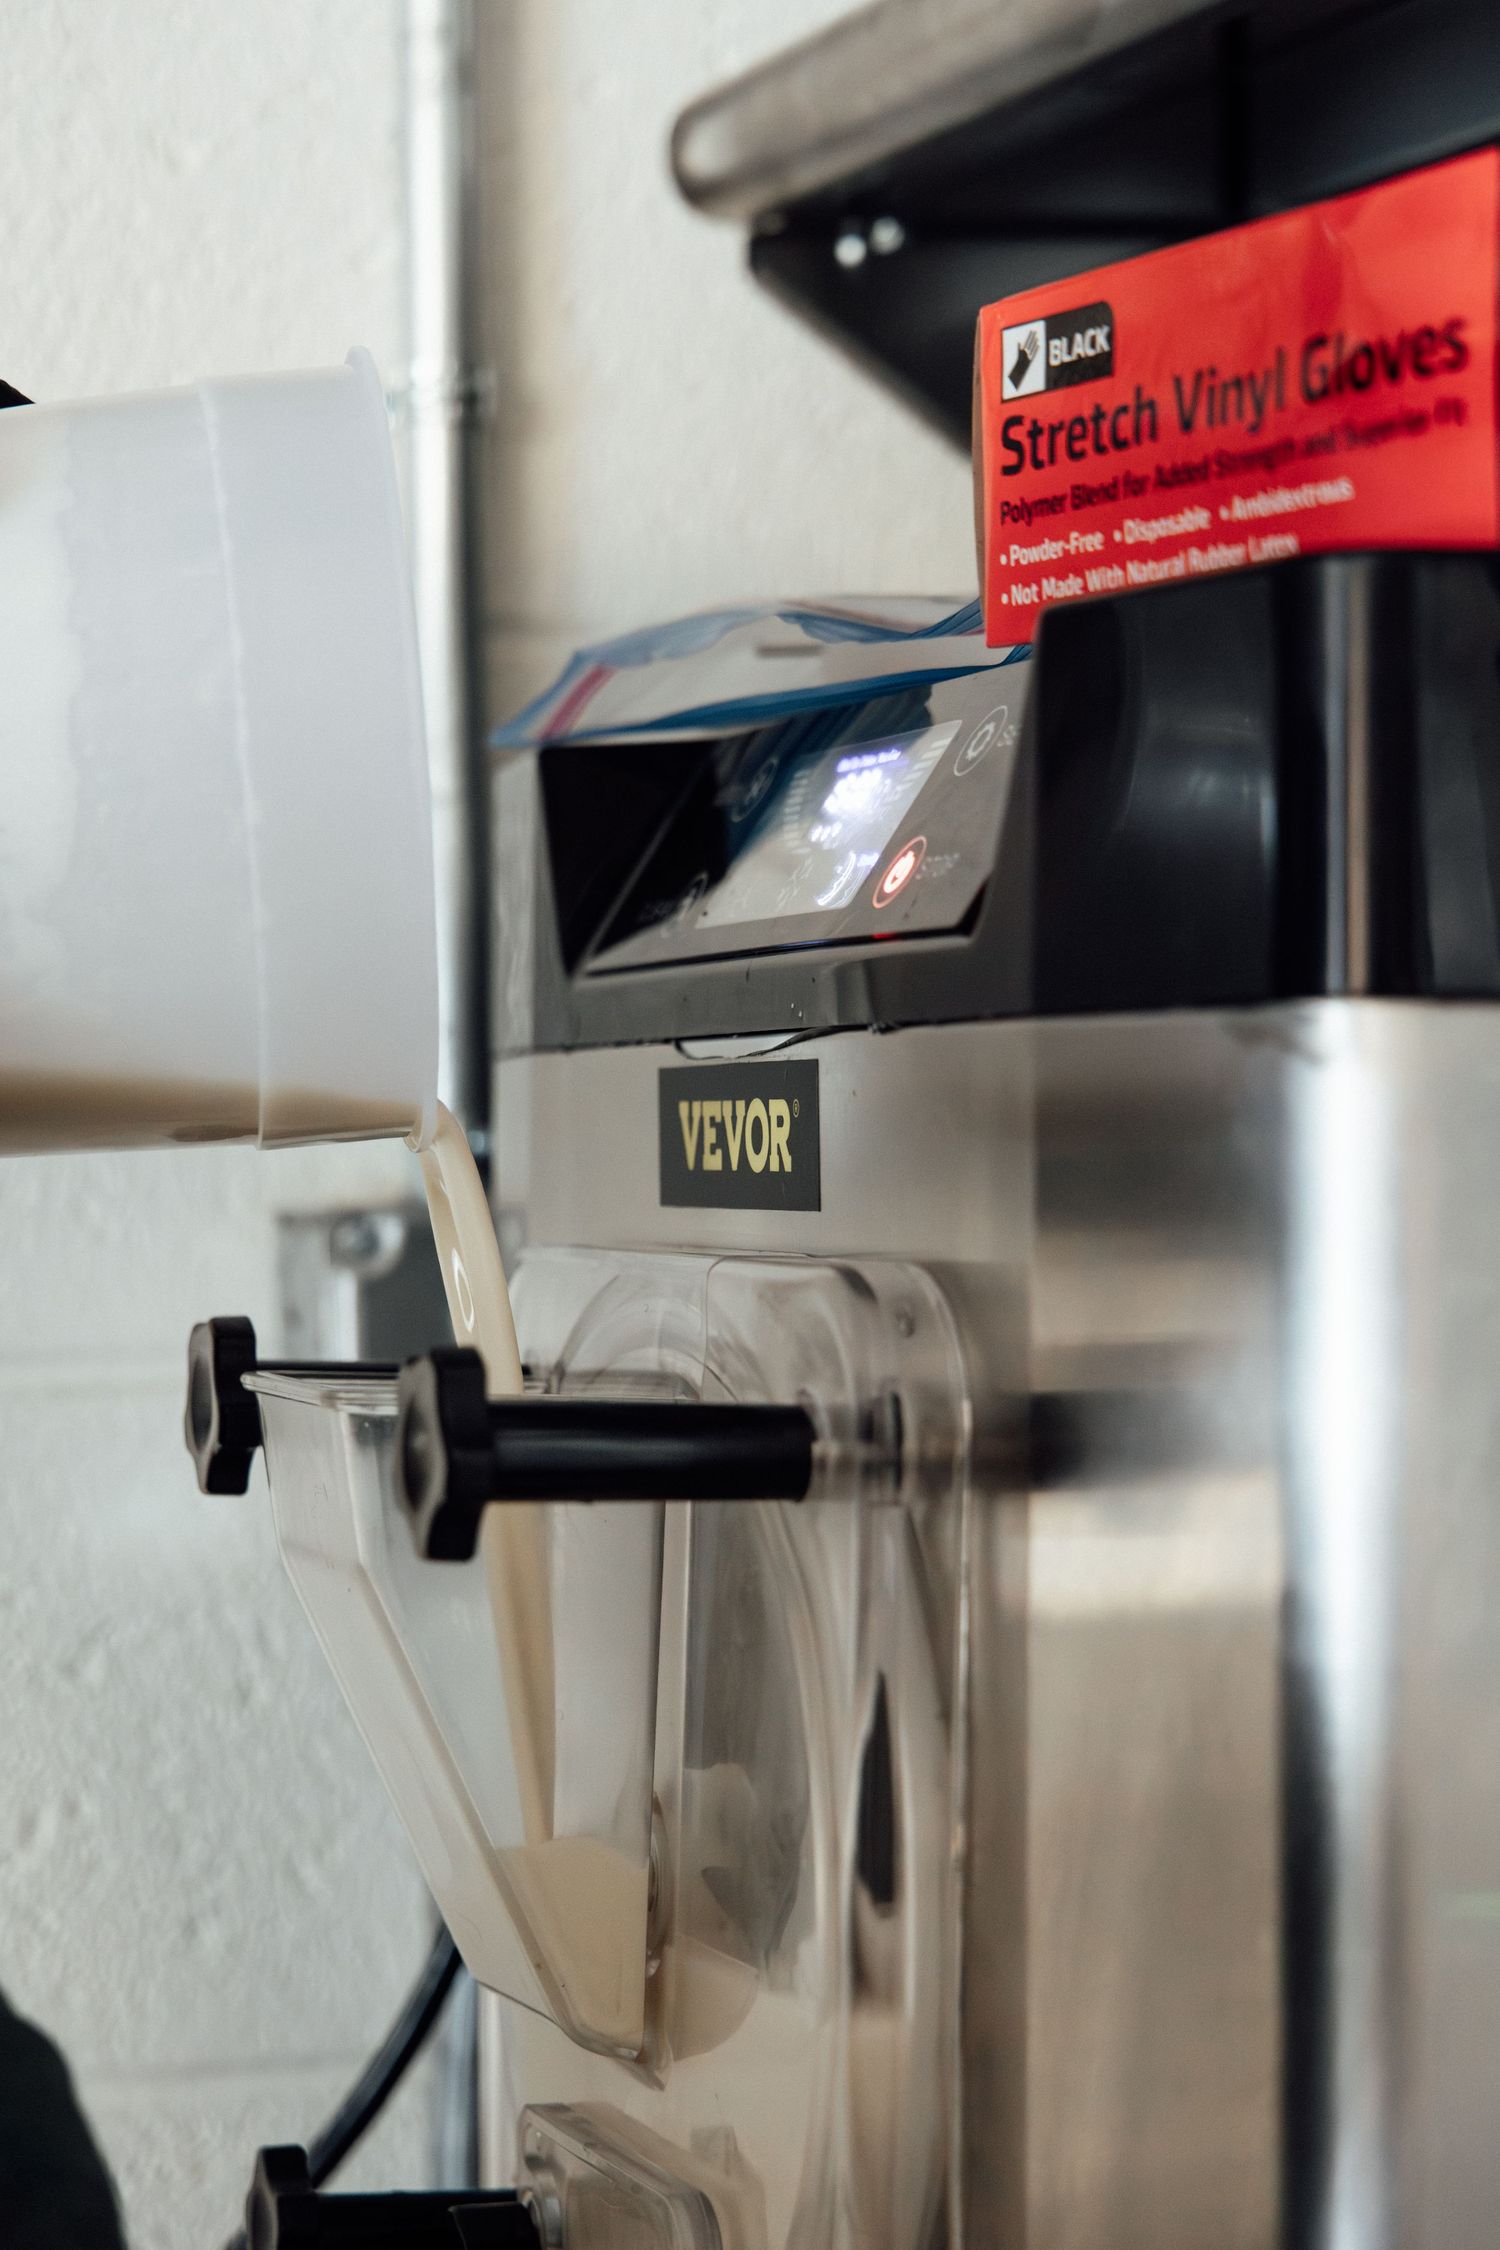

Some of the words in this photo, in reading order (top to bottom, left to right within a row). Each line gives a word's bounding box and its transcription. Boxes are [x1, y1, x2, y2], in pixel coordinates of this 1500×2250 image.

[1048, 324, 1111, 367] BLACK
[1000, 384, 1158, 477] Stretch
[1173, 344, 1287, 435] Vinyl
[1301, 316, 1470, 407] Gloves
[1000, 493, 1067, 527] Polymer
[1070, 477, 1120, 511] Blend
[1122, 469, 1150, 499] for
[1008, 530, 1106, 567] Powder-Free
[1123, 506, 1211, 543] Disposable
[1009, 583, 1040, 607] Not
[1040, 572, 1084, 601] Made
[1083, 562, 1125, 593] With
[1125, 549, 1186, 585] Natural
[678, 1097, 793, 1174] VEVOR
